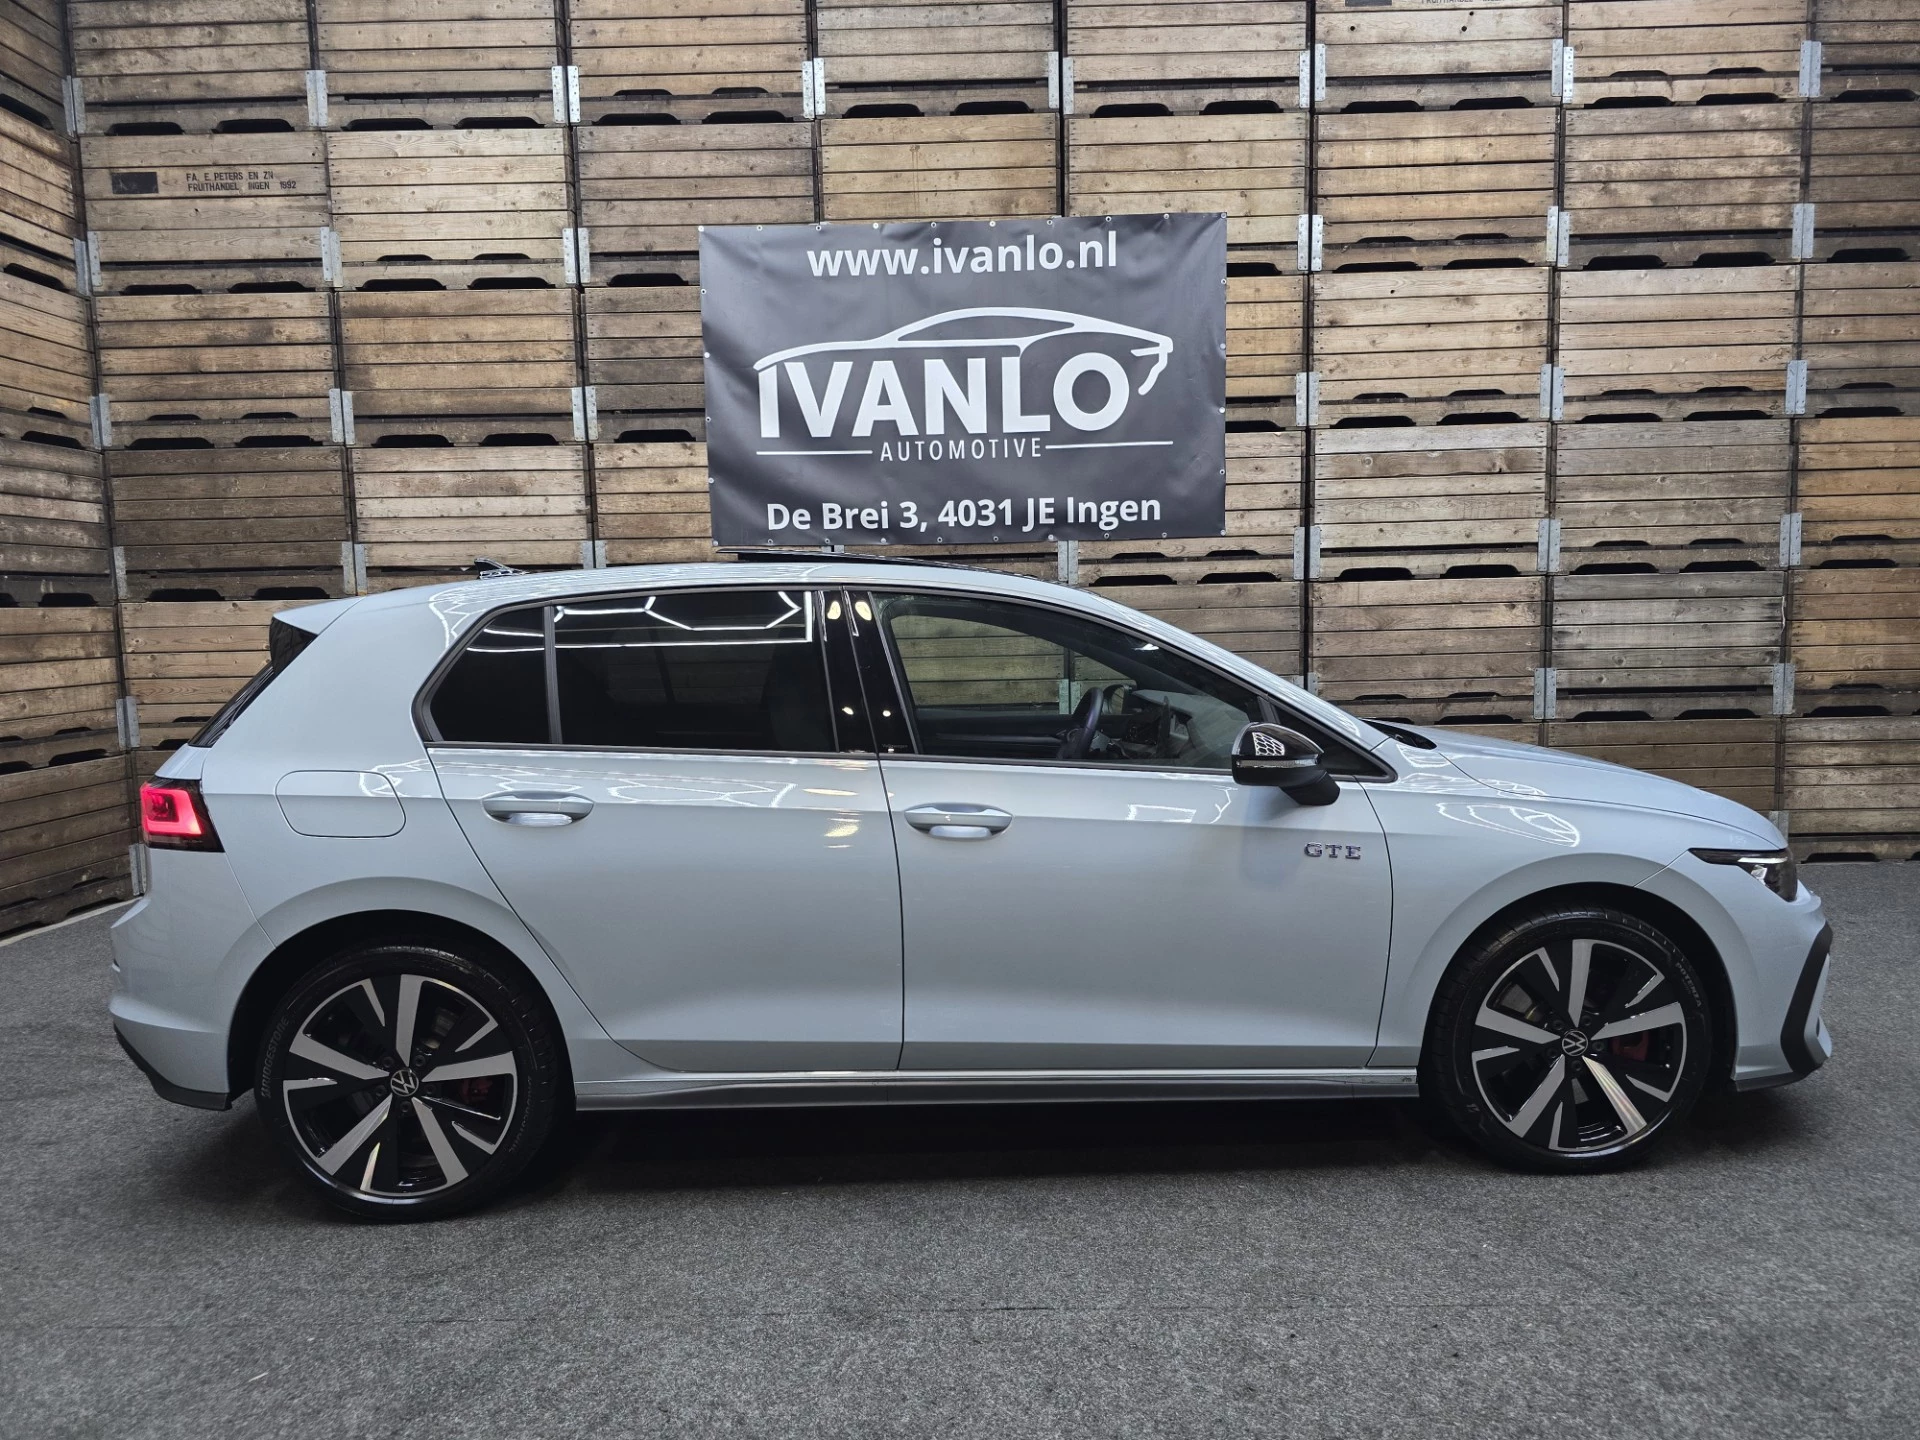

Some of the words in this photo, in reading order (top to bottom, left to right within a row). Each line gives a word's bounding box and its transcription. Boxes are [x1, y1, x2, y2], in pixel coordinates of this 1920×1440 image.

[187, 181, 239, 192] FRUITHANDEL
[248, 181, 270, 190] INGEN
[213, 171, 243, 181] PETERS
[248, 171, 259, 180] EN
[806, 230, 1117, 277] www.ivanlo.nl
[757, 352, 1131, 439] IVANLO
[880, 437, 1042, 462] AUTOMOTIVE
[767, 503, 811, 531] De
[822, 500, 889, 530] Brei
[899, 501, 928, 533] 3,
[937, 498, 1012, 527] 4031
[1022, 497, 1055, 533] JE
[1067, 496, 1161, 531] Ingen
[1304, 842, 1361, 860] GTE
